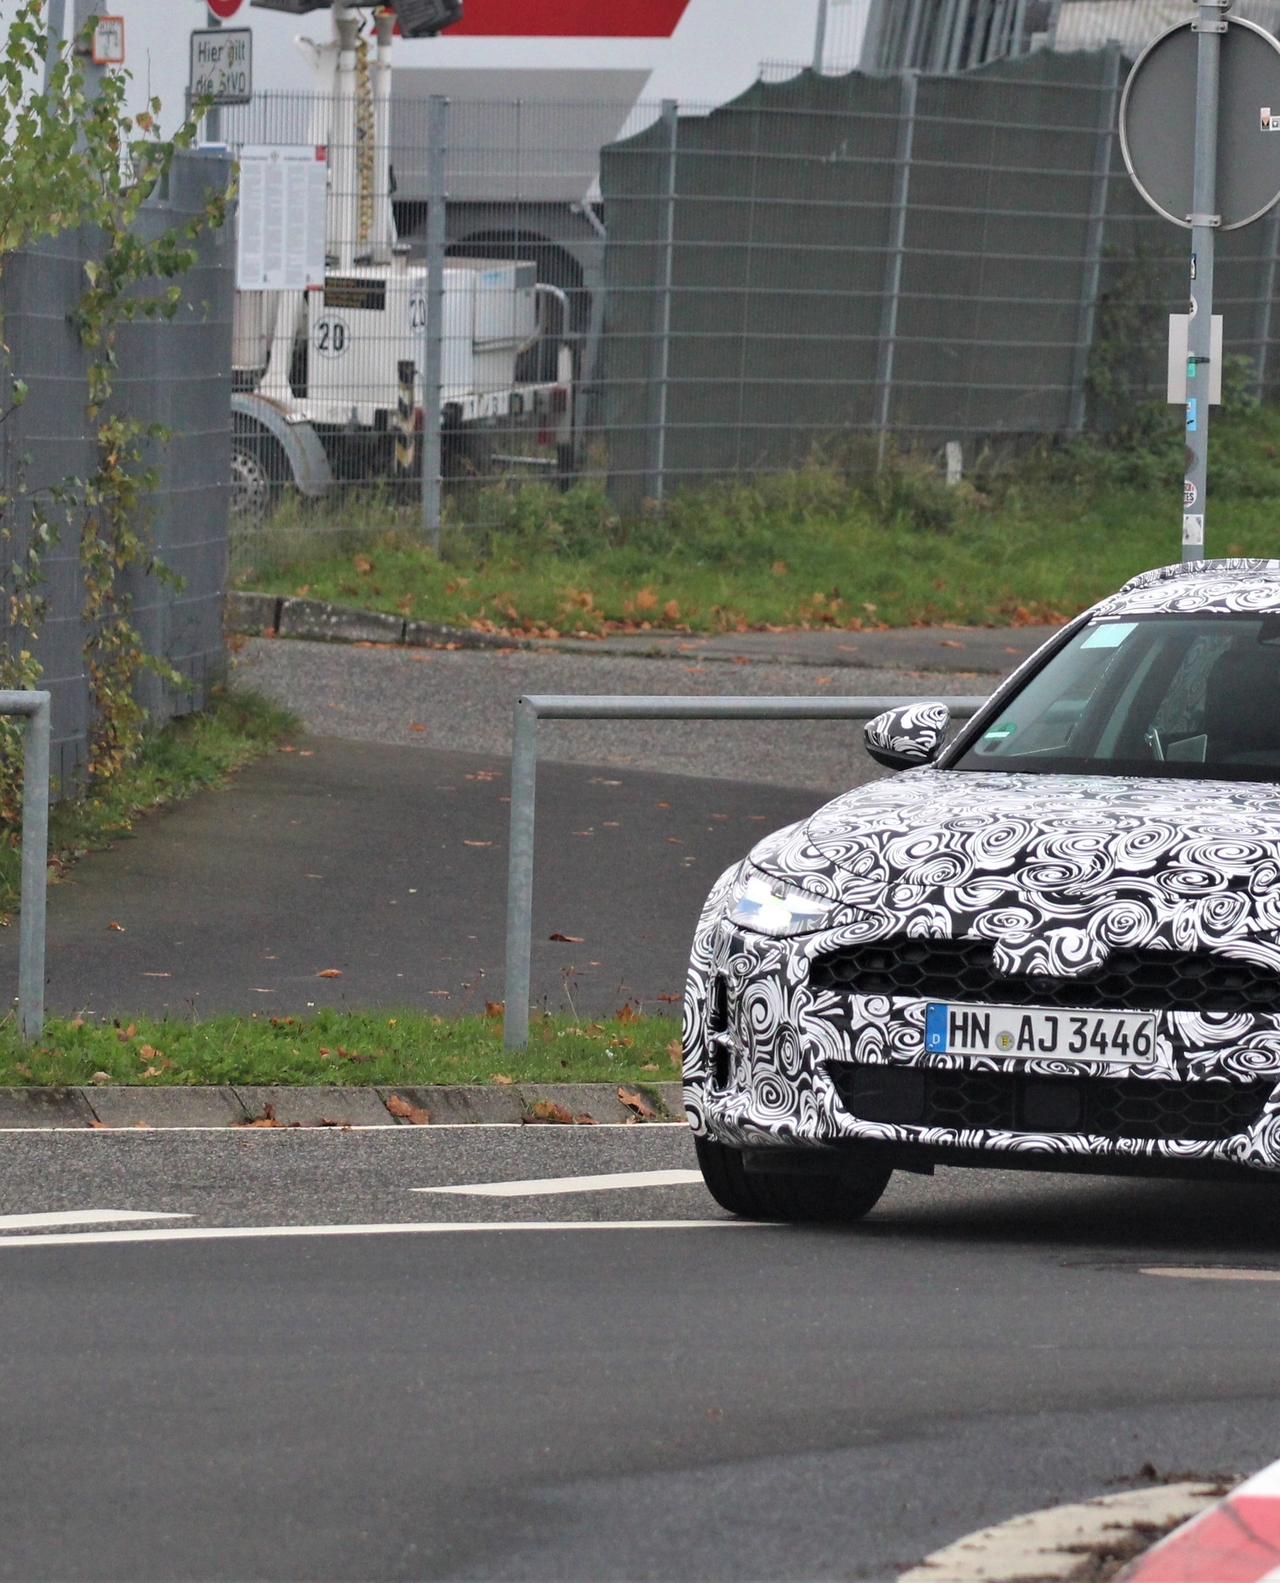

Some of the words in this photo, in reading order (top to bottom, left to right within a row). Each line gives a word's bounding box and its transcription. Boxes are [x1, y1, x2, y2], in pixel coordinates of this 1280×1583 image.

[198, 41, 223, 62] Hier
[196, 74, 214, 94] die
[218, 72, 246, 95] StVO
[318, 322, 345, 351] 20
[932, 1033, 941, 1045] D
[949, 1010, 991, 1049] HN
[1016, 1014, 1059, 1053] AJ
[1068, 1016, 1152, 1057] 3446
